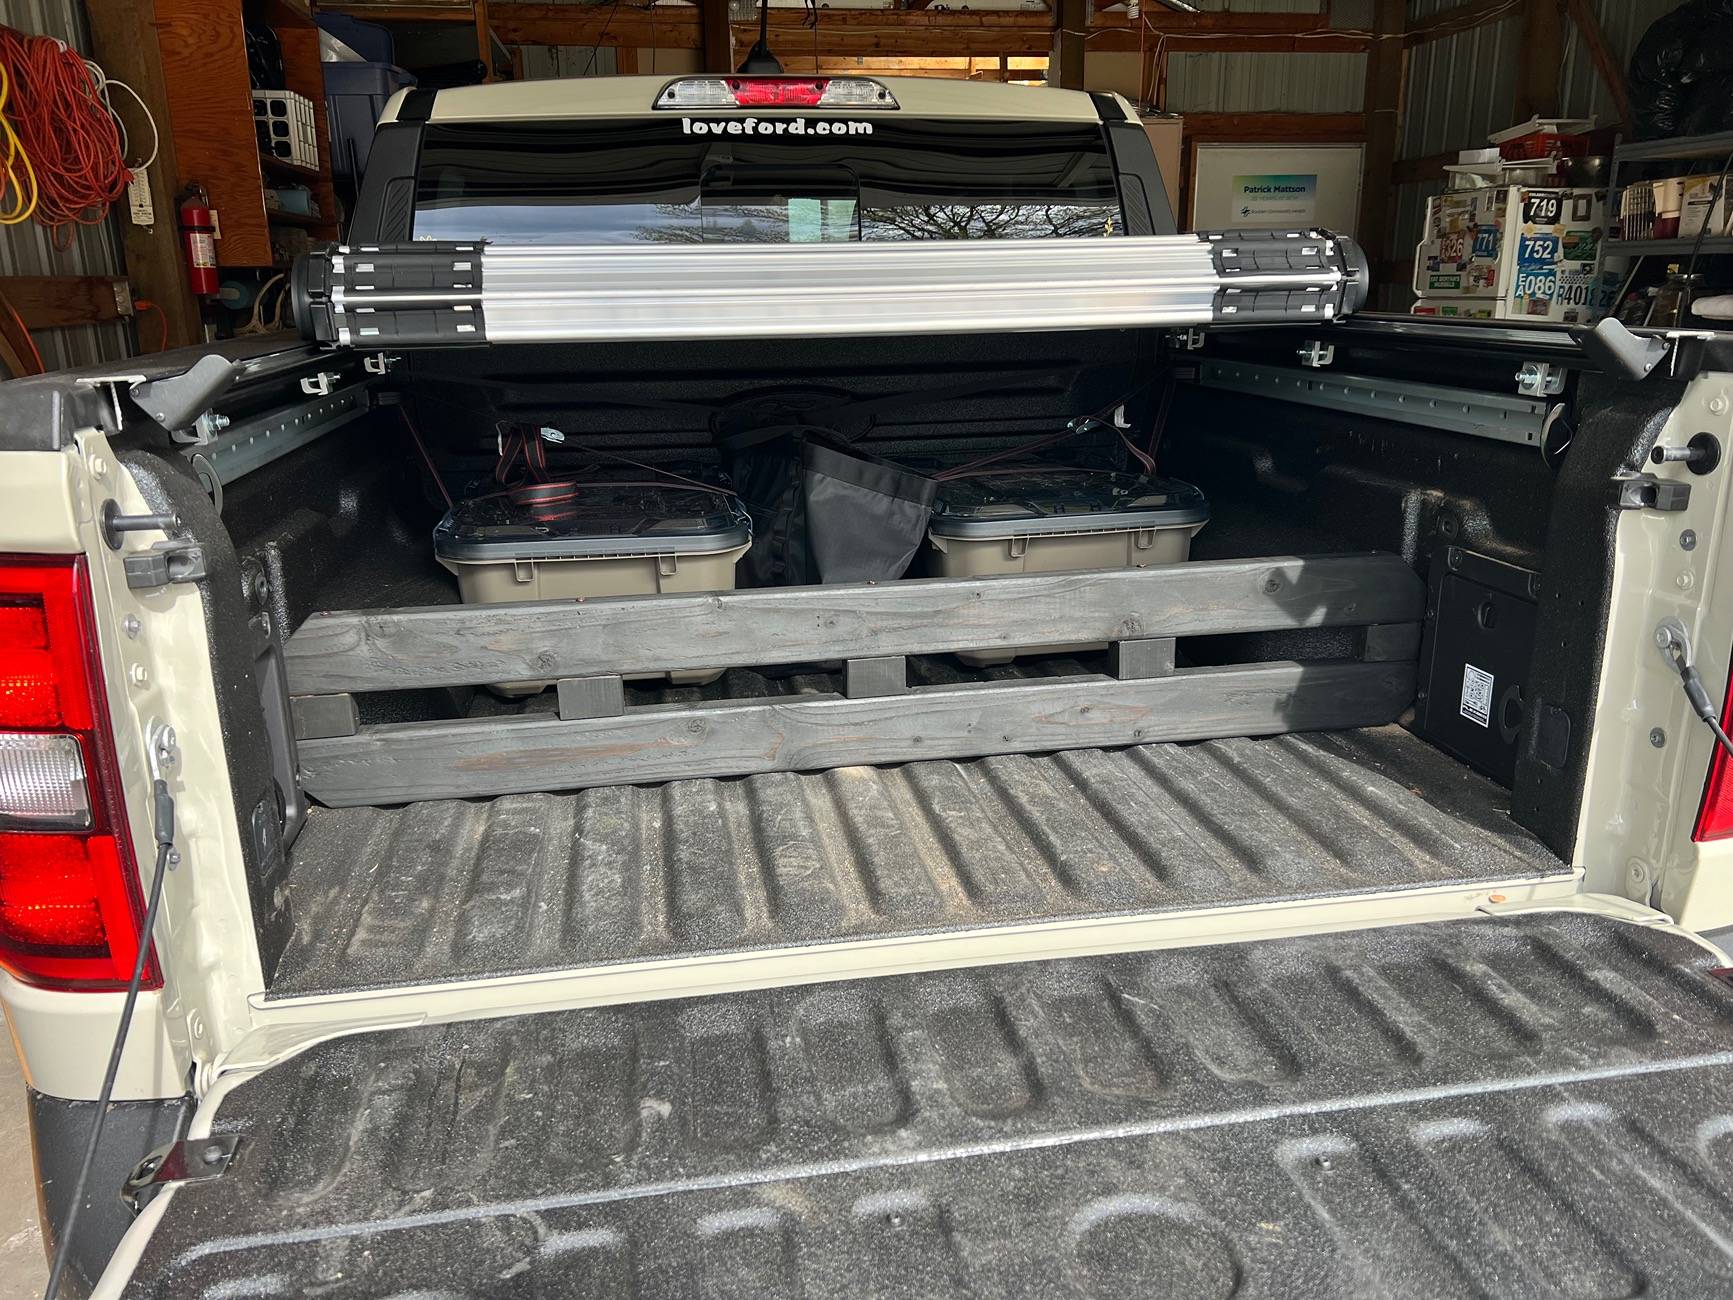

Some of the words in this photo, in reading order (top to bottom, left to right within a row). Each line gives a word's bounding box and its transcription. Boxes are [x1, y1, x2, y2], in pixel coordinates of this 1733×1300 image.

[682, 117, 873, 135] loveford.com
[1244, 185, 1271, 193] Patrick
[1273, 185, 1306, 193] Mattson
[1529, 198, 1557, 217] 719
[1476, 233, 1494, 250] 771
[1524, 240, 1553, 259] 752
